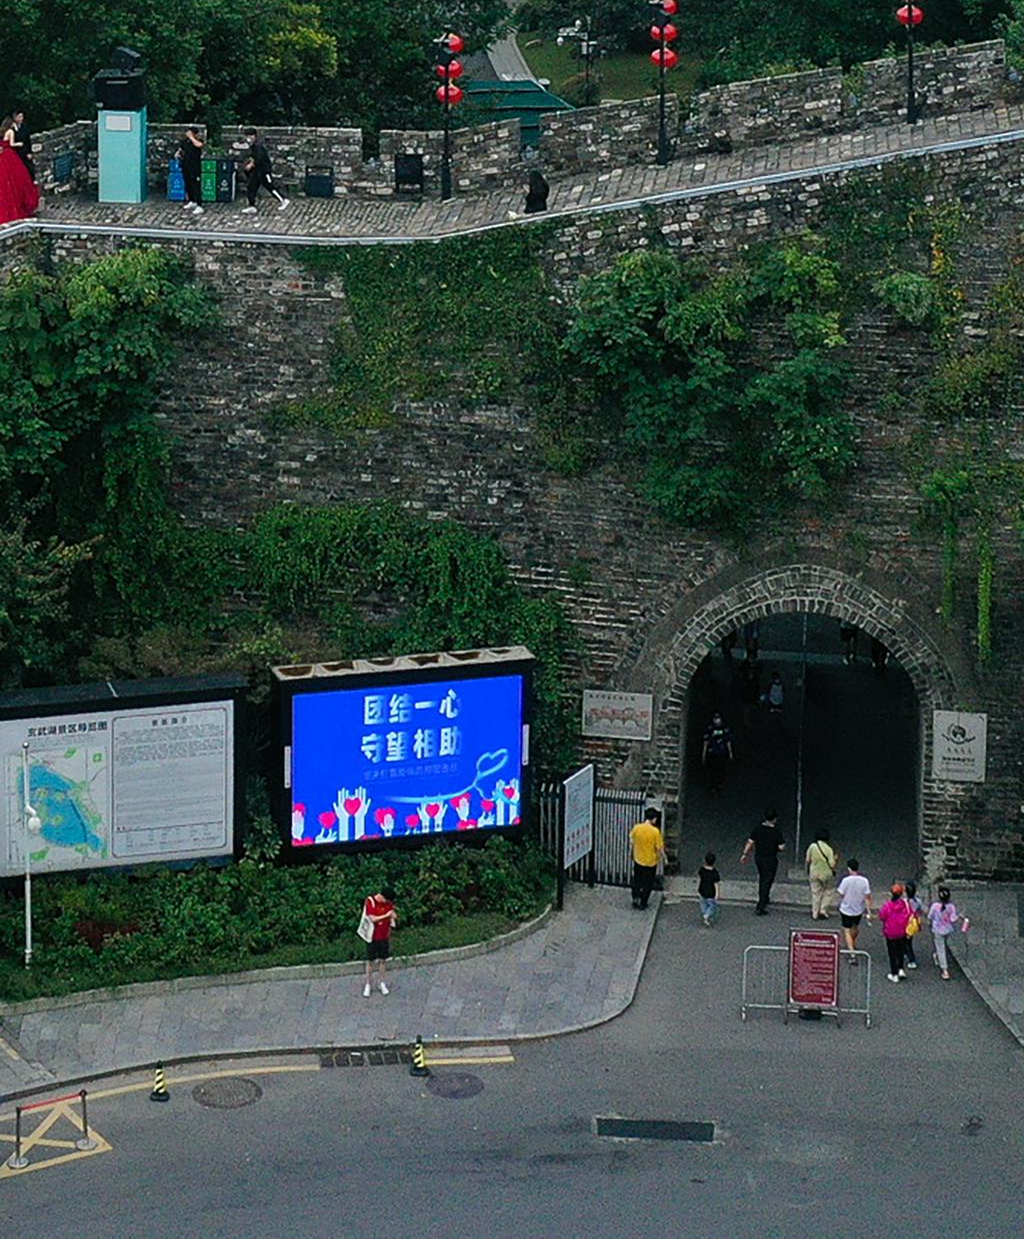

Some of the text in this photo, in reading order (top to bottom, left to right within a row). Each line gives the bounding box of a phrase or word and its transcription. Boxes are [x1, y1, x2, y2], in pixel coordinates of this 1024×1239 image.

[364, 689, 461, 725] 团结一心
[361, 725, 461, 763] 守望相助
